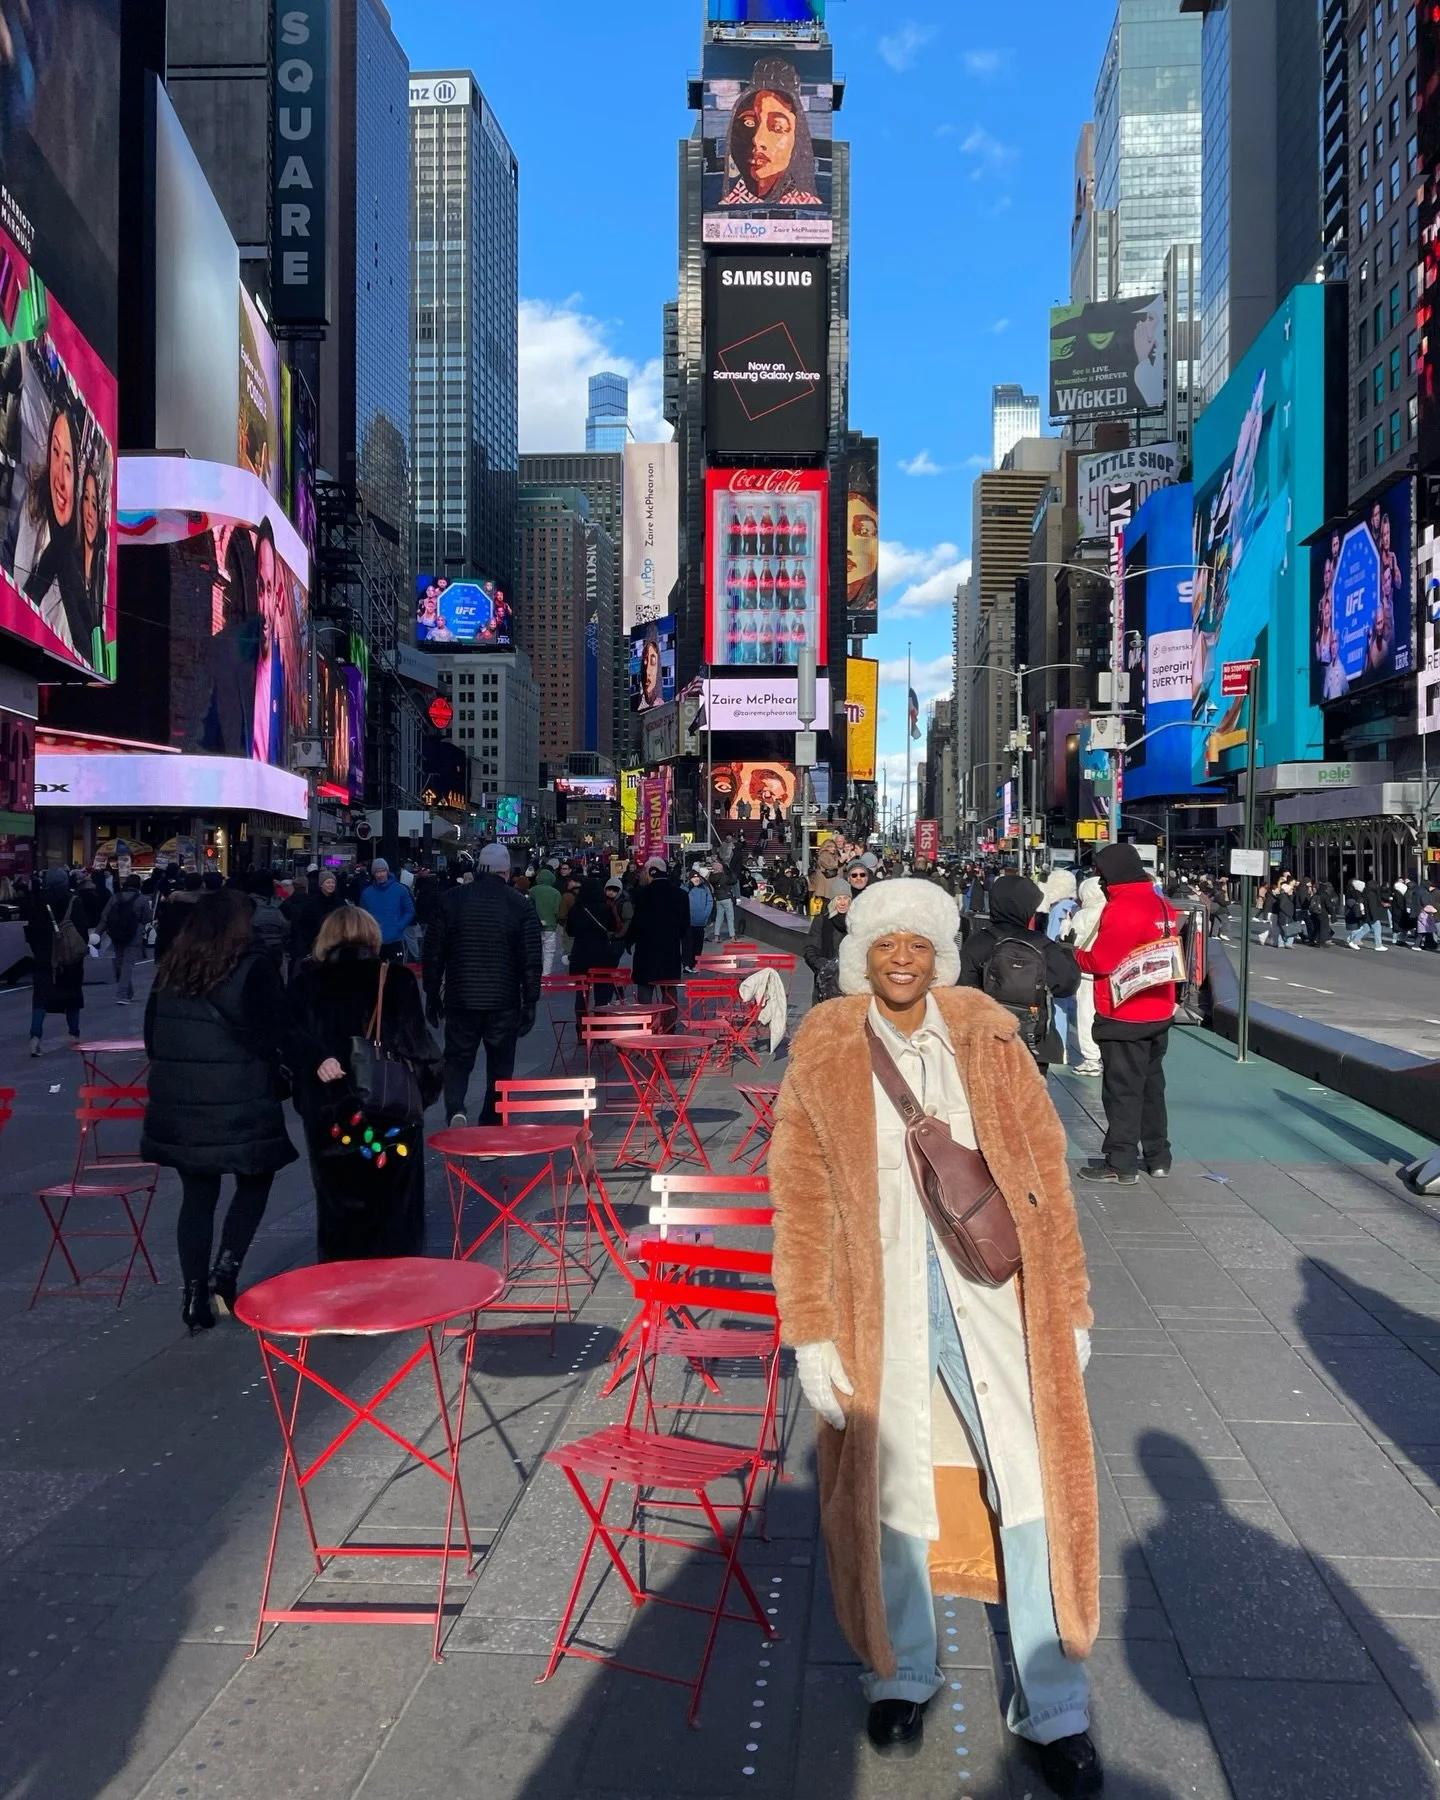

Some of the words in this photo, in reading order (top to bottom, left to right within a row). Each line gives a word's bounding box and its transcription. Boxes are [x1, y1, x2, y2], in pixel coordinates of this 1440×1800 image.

[277, 11, 314, 285] SQUARE
[1, 185, 35, 240] MARRIOTT
[1, 205, 31, 254] MARQUIS
[723, 222, 766, 236] ArtPop
[722, 270, 812, 287] SAMSUNG
[713, 370, 758, 382] Samsung
[759, 370, 794, 382] Galaxy
[795, 371, 820, 380] Store
[748, 361, 770, 371] Now
[772, 362, 785, 371] on
[1054, 377, 1088, 386] Remember
[1088, 452, 1135, 483] LITTLE
[1139, 451, 1174, 473] SHOP
[645, 462, 654, 519] McPhearson
[729, 468, 804, 493] Coca-Cola
[645, 521, 654, 547] Zaire
[641, 558, 654, 600] ArtPop
[455, 606, 477, 616] UFC
[1345, 587, 1366, 618] UFC
[1223, 665, 1231, 673] NO
[1231, 663, 1253, 672] STOPPIN
[1223, 673, 1242, 682] Anytime
[712, 694, 742, 705] Zaire
[746, 693, 798, 705] McPhear
[733, 710, 797, 718] @zairemcphearson
[921, 822, 934, 850] tkts
